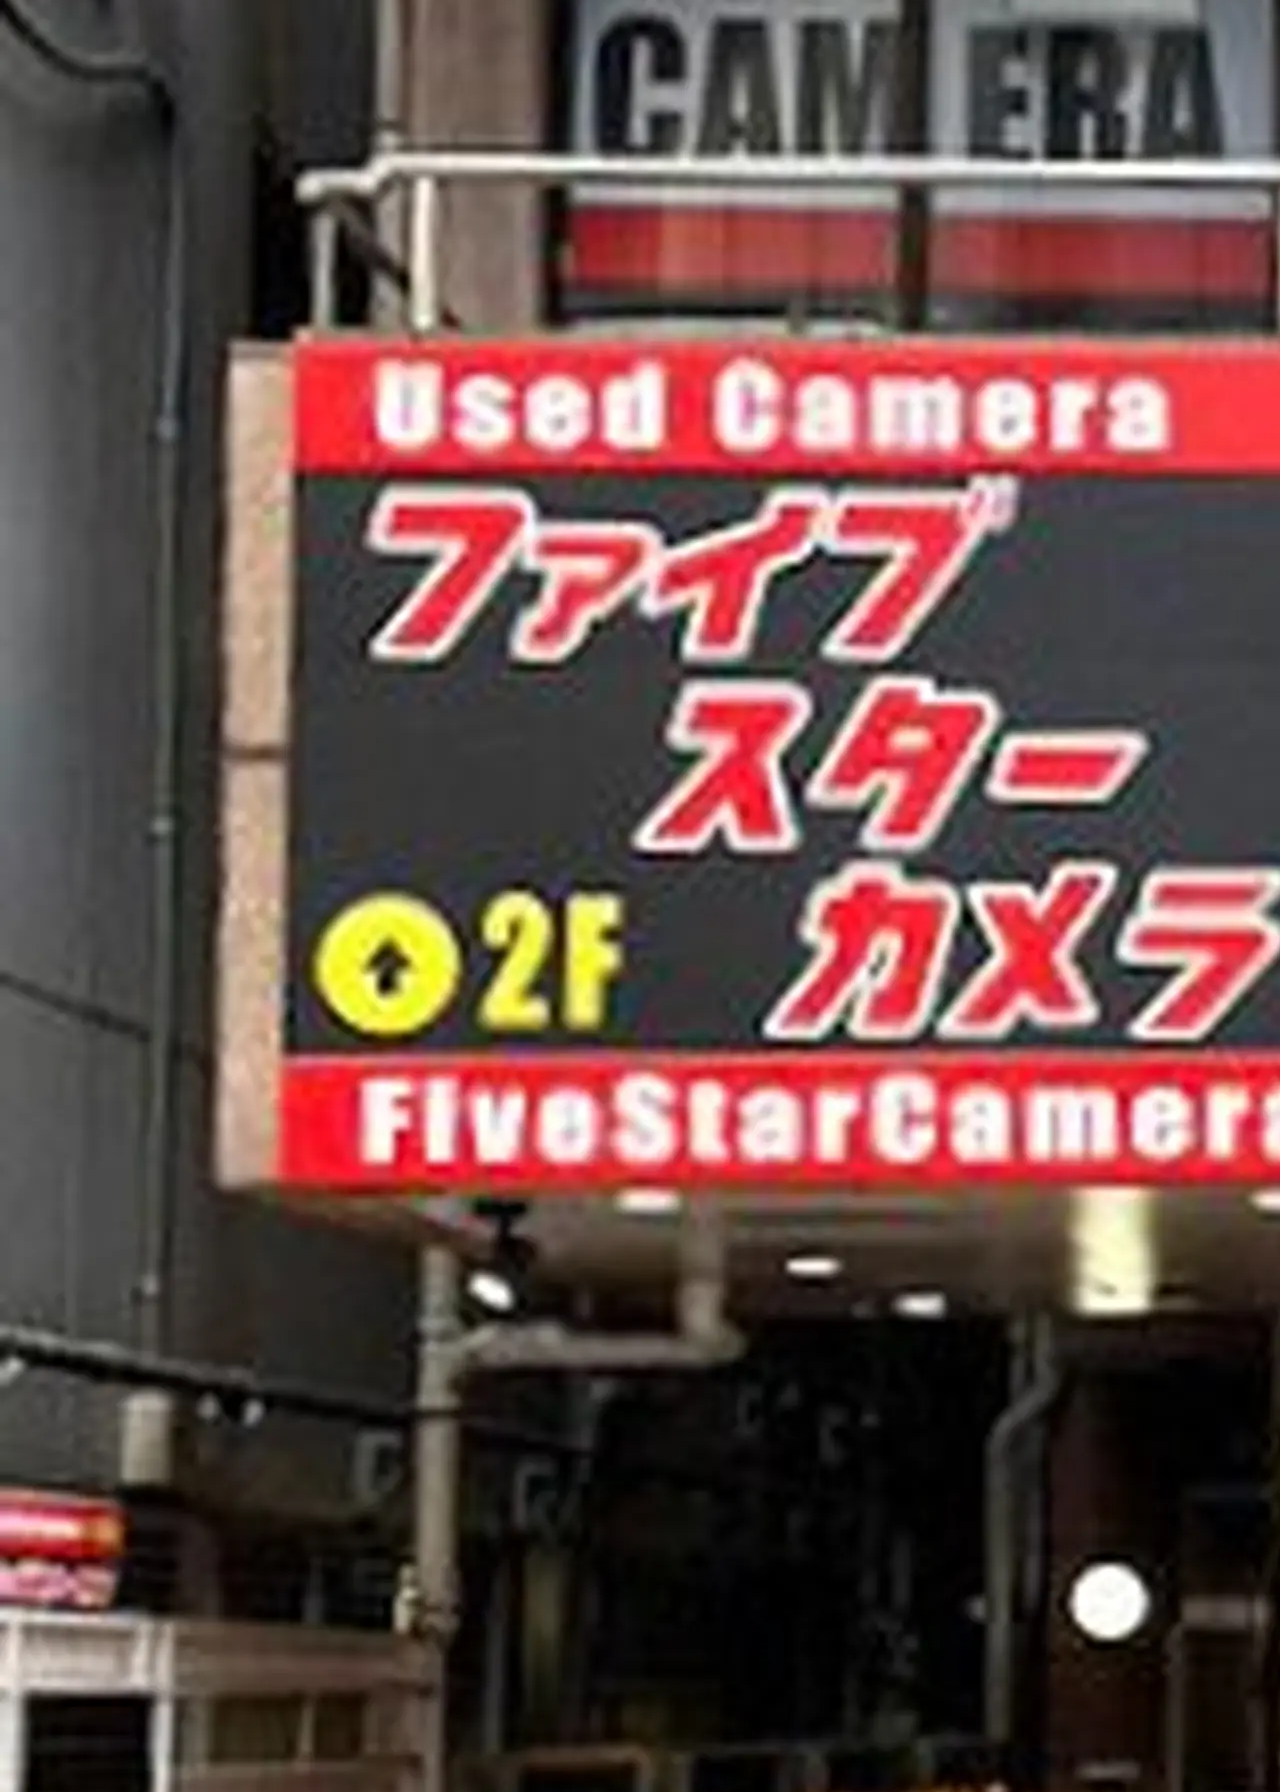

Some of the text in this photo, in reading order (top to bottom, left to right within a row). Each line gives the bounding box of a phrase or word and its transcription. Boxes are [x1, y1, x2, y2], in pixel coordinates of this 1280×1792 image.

[373, 362, 1173, 451] Used Camera
[368, 480, 1018, 664] ファイブ
[634, 677, 1147, 852] スター
[477, 888, 625, 1032] 2F
